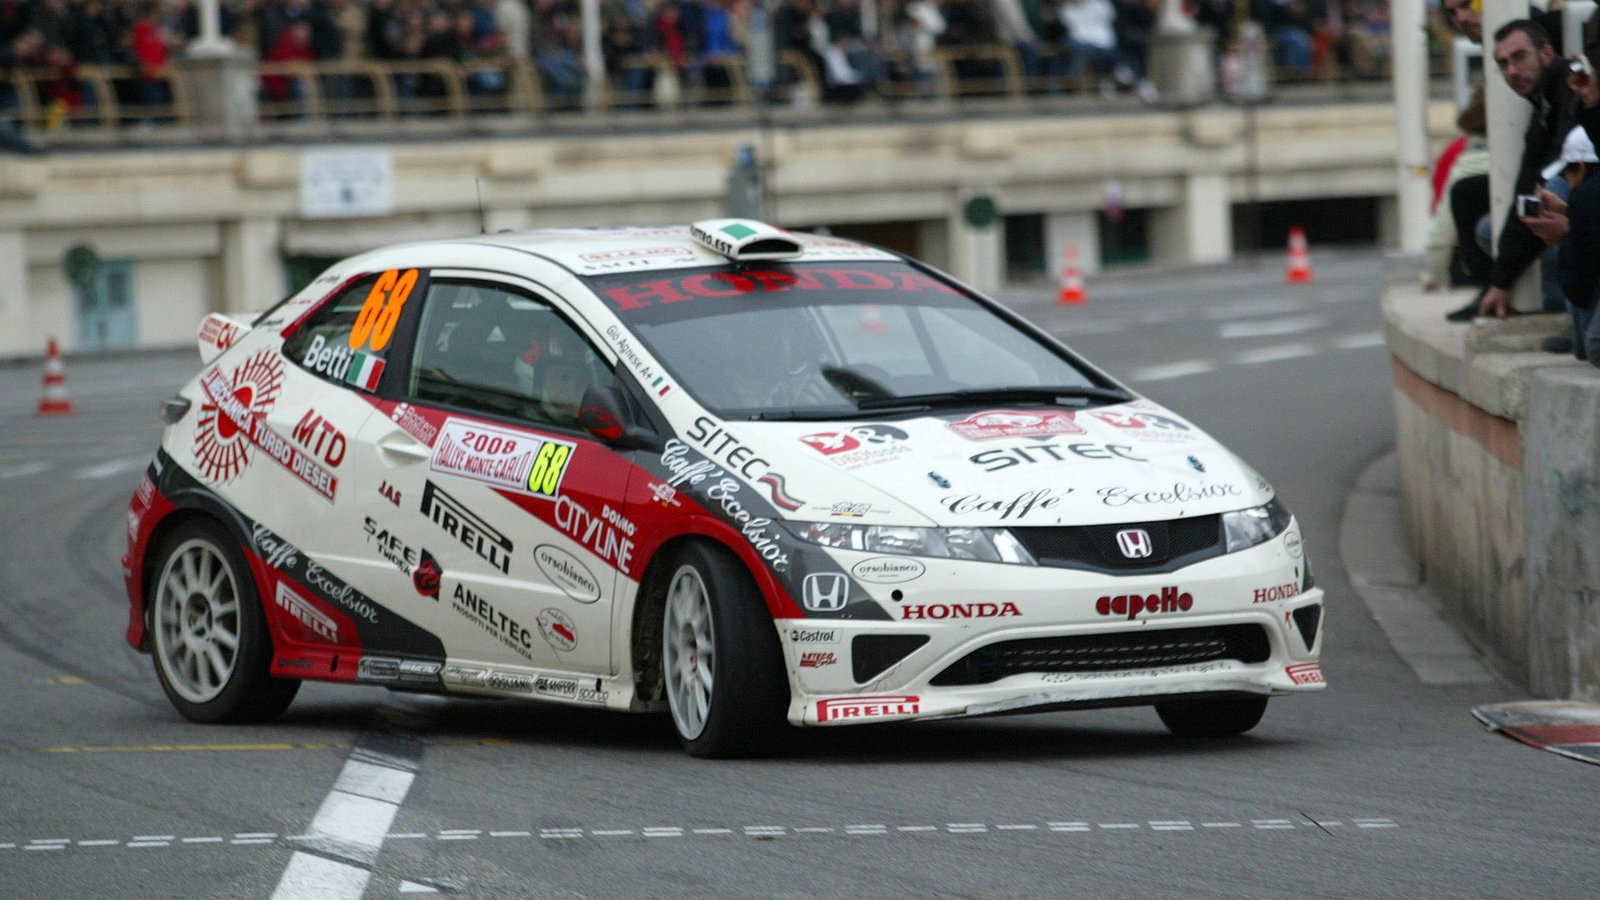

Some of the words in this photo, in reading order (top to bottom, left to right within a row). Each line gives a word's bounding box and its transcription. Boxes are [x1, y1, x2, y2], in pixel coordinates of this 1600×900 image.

[349, 268, 419, 351] 68
[602, 267, 971, 311] HONDA
[303, 335, 354, 380] Betti
[617, 338, 643, 369] Agnese
[208, 379, 252, 434] MECCANICA
[253, 418, 292, 464] TURBO
[292, 451, 334, 497] DIESEL
[292, 408, 347, 468] MTD
[435, 433, 466, 470] RALLYE
[461, 431, 517, 455] 2008
[686, 416, 771, 479] SITEC
[969, 443, 1148, 472] SITEC
[528, 442, 569, 495] 68
[1096, 481, 1242, 507] Excelsior
[363, 516, 416, 567] SAFE
[420, 478, 514, 576] PIRELLI
[602, 504, 636, 537] DOIMO
[707, 477, 789, 572] Excelsior
[541, 552, 595, 593] orsobianco
[859, 562, 918, 573] orsobianco
[275, 580, 338, 644] PIRELLI
[306, 560, 379, 624] Excelsior
[901, 602, 1023, 620] HONDA
[1253, 582, 1300, 603] HONDA
[454, 583, 532, 649] ANELTEC
[800, 630, 834, 641] Castrol
[816, 695, 920, 722] PIRELLI
